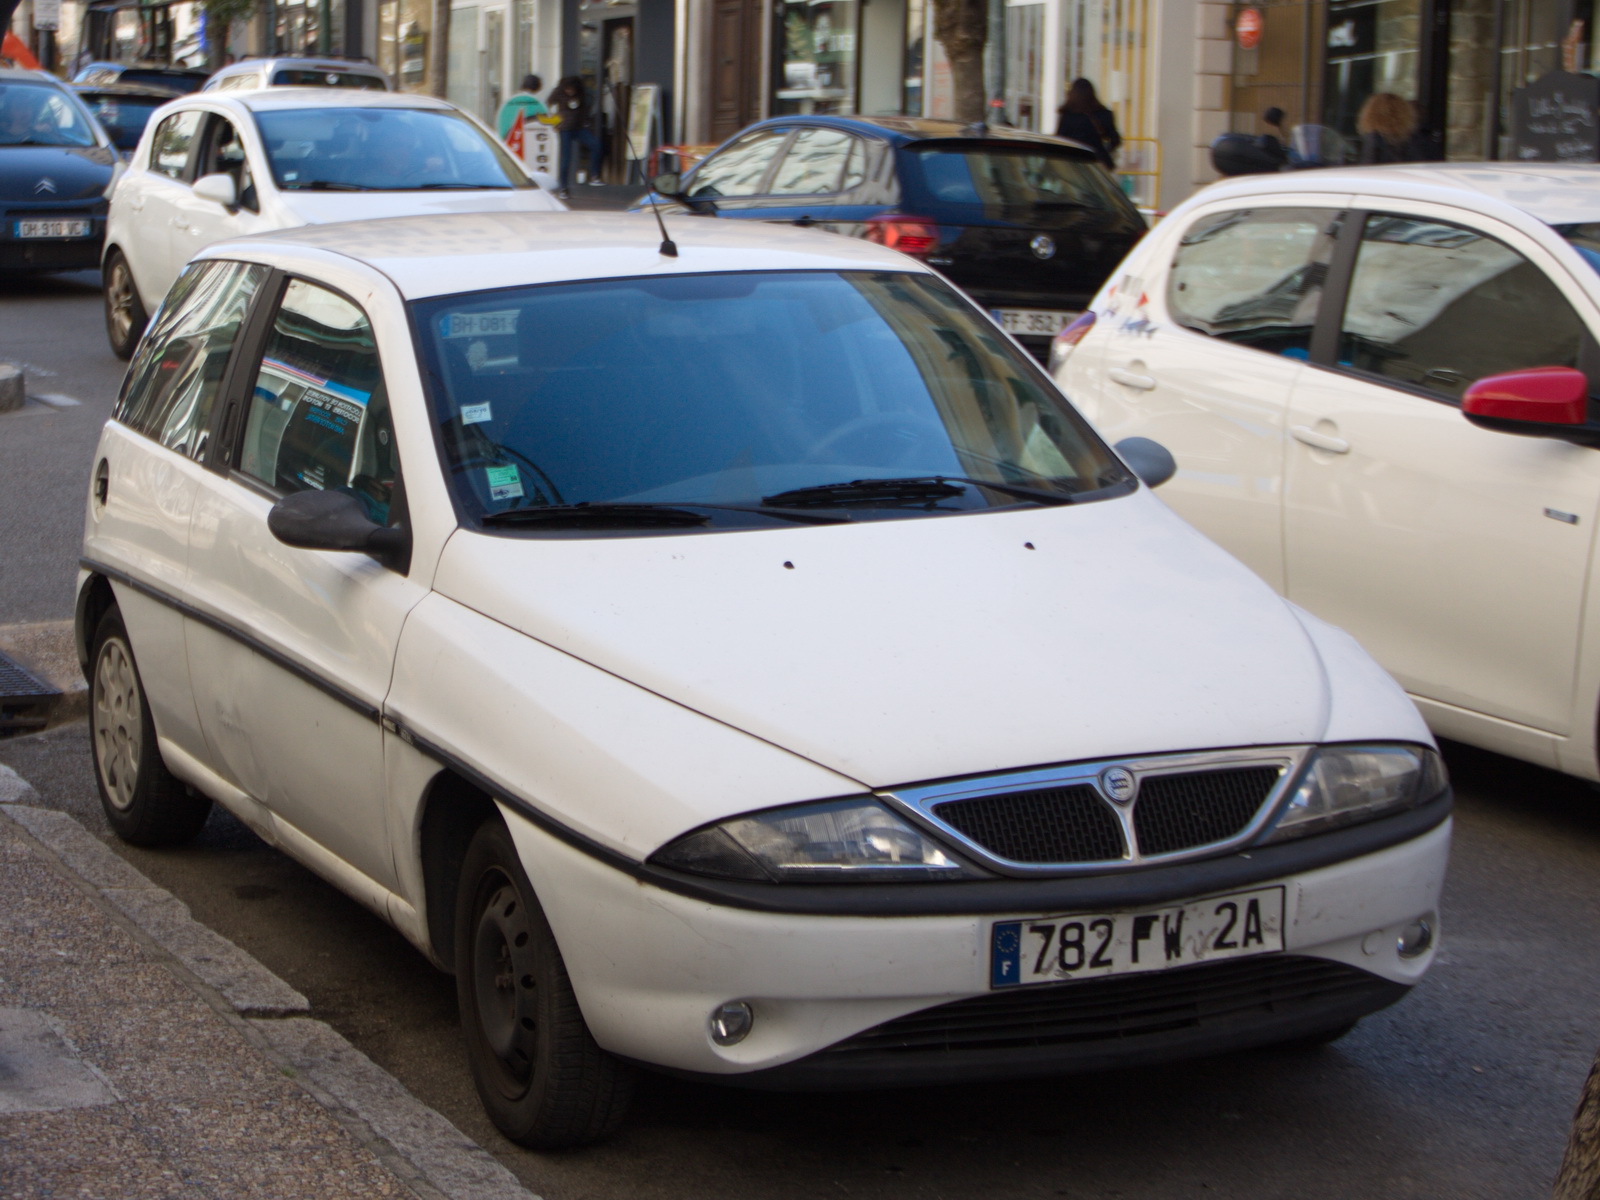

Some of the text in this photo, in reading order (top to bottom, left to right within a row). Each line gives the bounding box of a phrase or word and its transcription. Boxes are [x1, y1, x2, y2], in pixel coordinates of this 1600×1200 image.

[1029, 918, 1113, 974] 782
[1213, 898, 1263, 951] 2A
[1001, 960, 1012, 976] F
